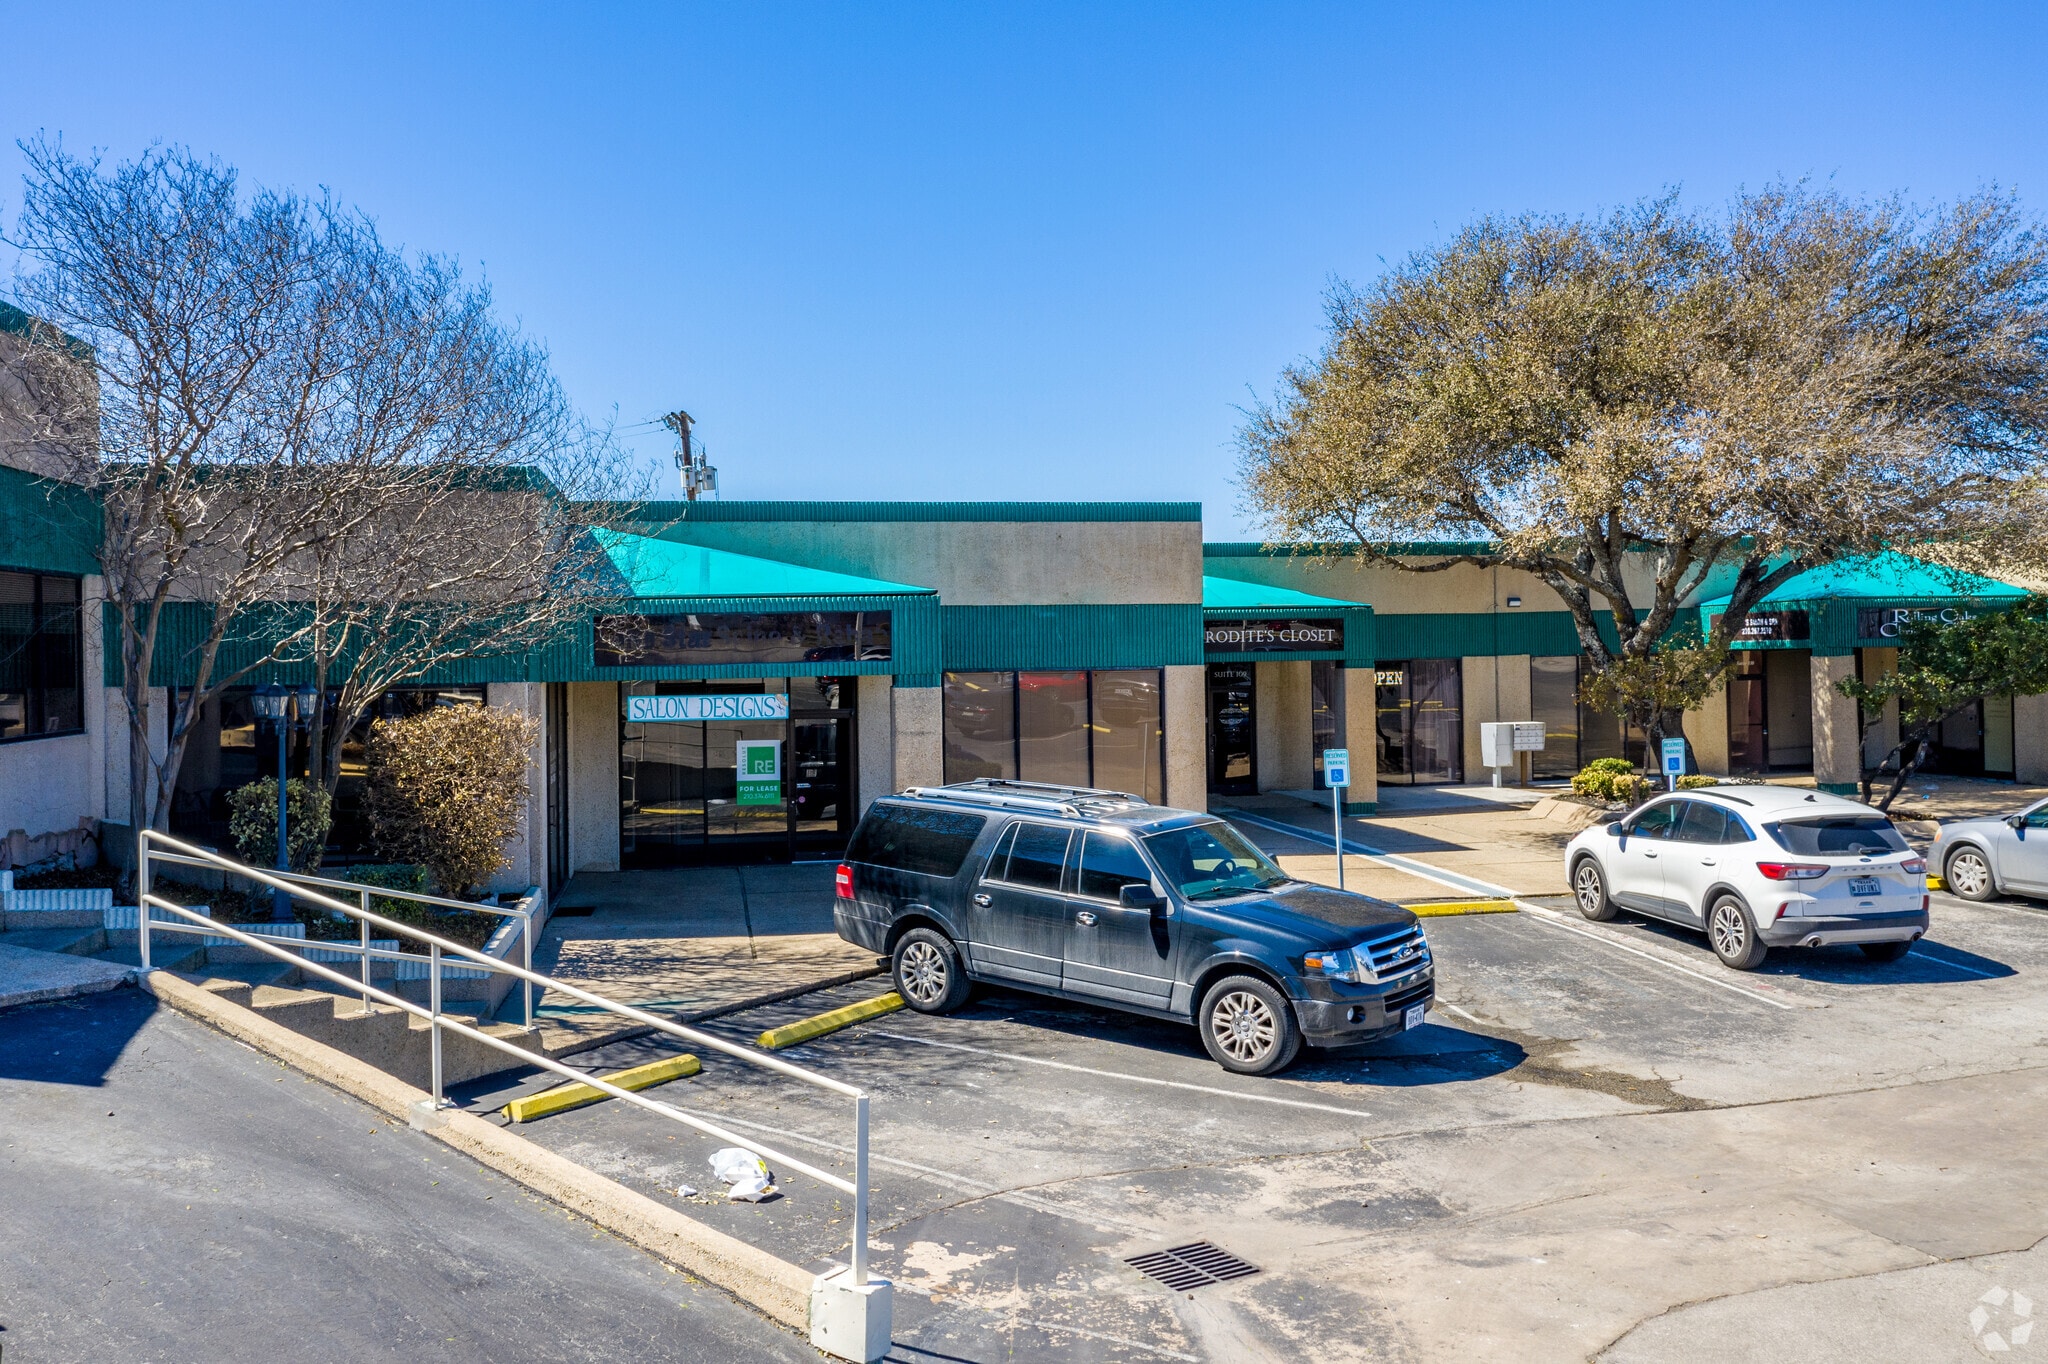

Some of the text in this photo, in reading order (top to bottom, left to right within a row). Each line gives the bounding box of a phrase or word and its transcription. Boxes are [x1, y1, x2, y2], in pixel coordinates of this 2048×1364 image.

[1205, 629, 1336, 643] RODITE'S CLOSET
[1214, 670, 1234, 678] SUITE
[1373, 671, 1404, 686] PEN
[633, 696, 776, 719] SALON DESIGNS
[754, 760, 774, 773] RE
